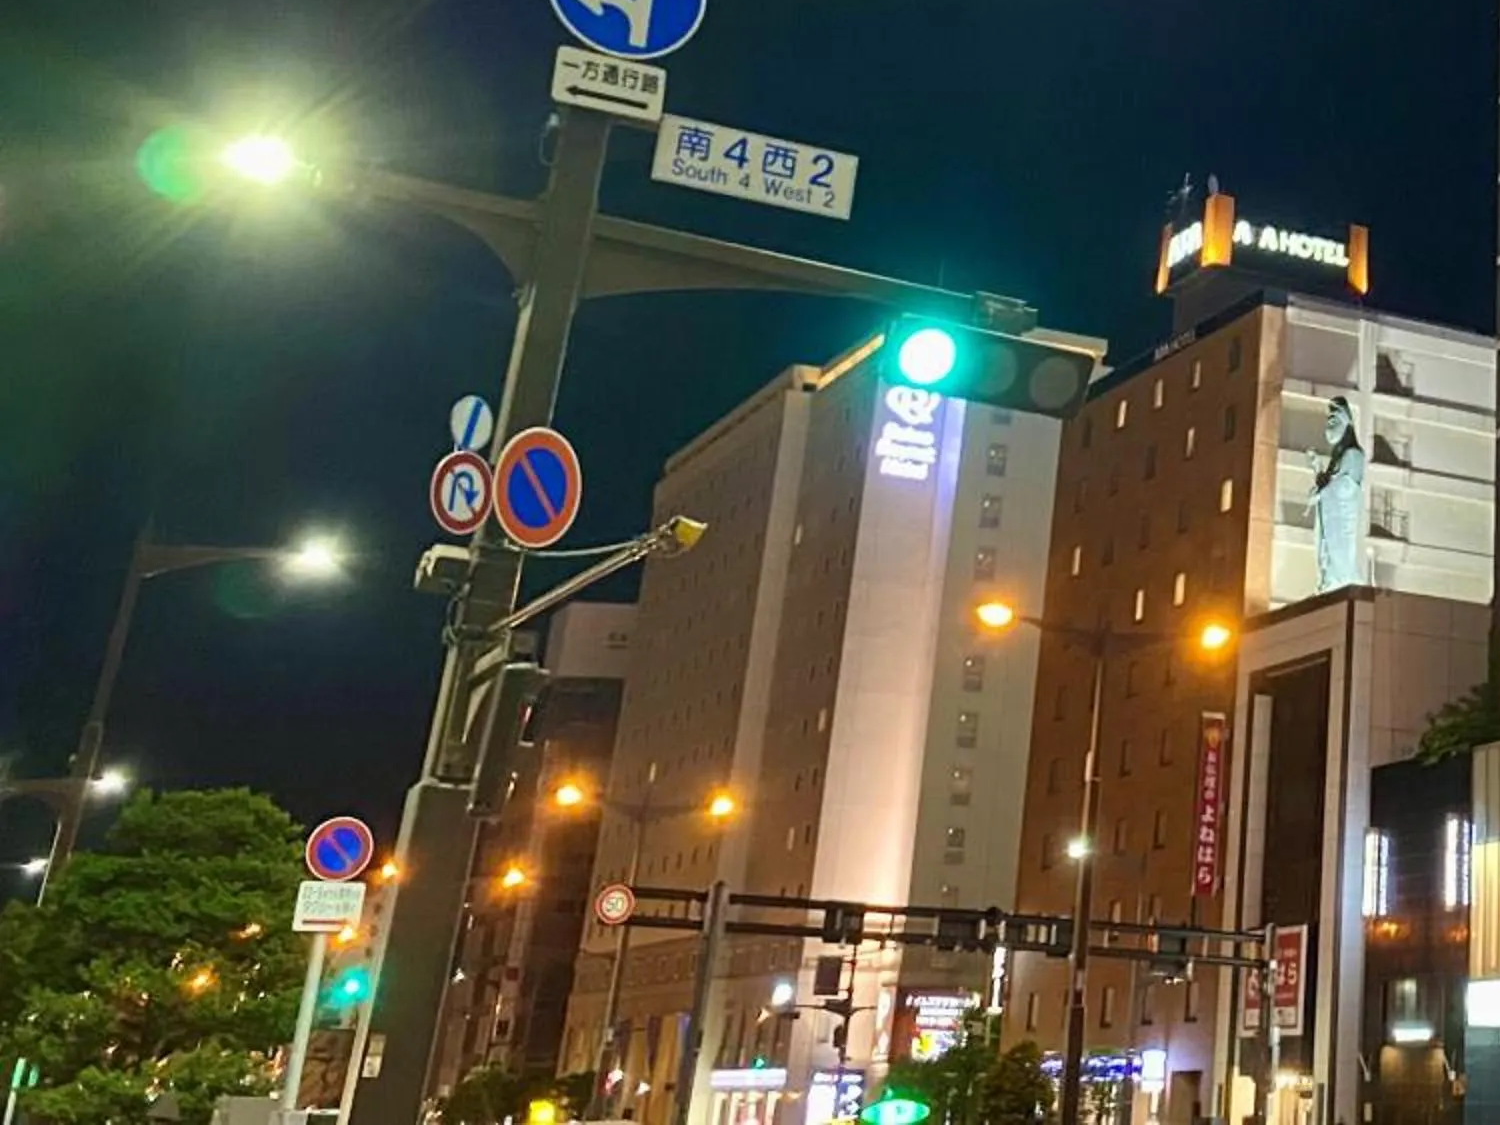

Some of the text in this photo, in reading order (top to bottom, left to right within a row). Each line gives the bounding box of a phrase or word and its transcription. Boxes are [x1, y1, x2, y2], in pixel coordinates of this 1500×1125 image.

[671, 158, 836, 208] South 4 West 2
[1279, 231, 1350, 268] HOTEL
